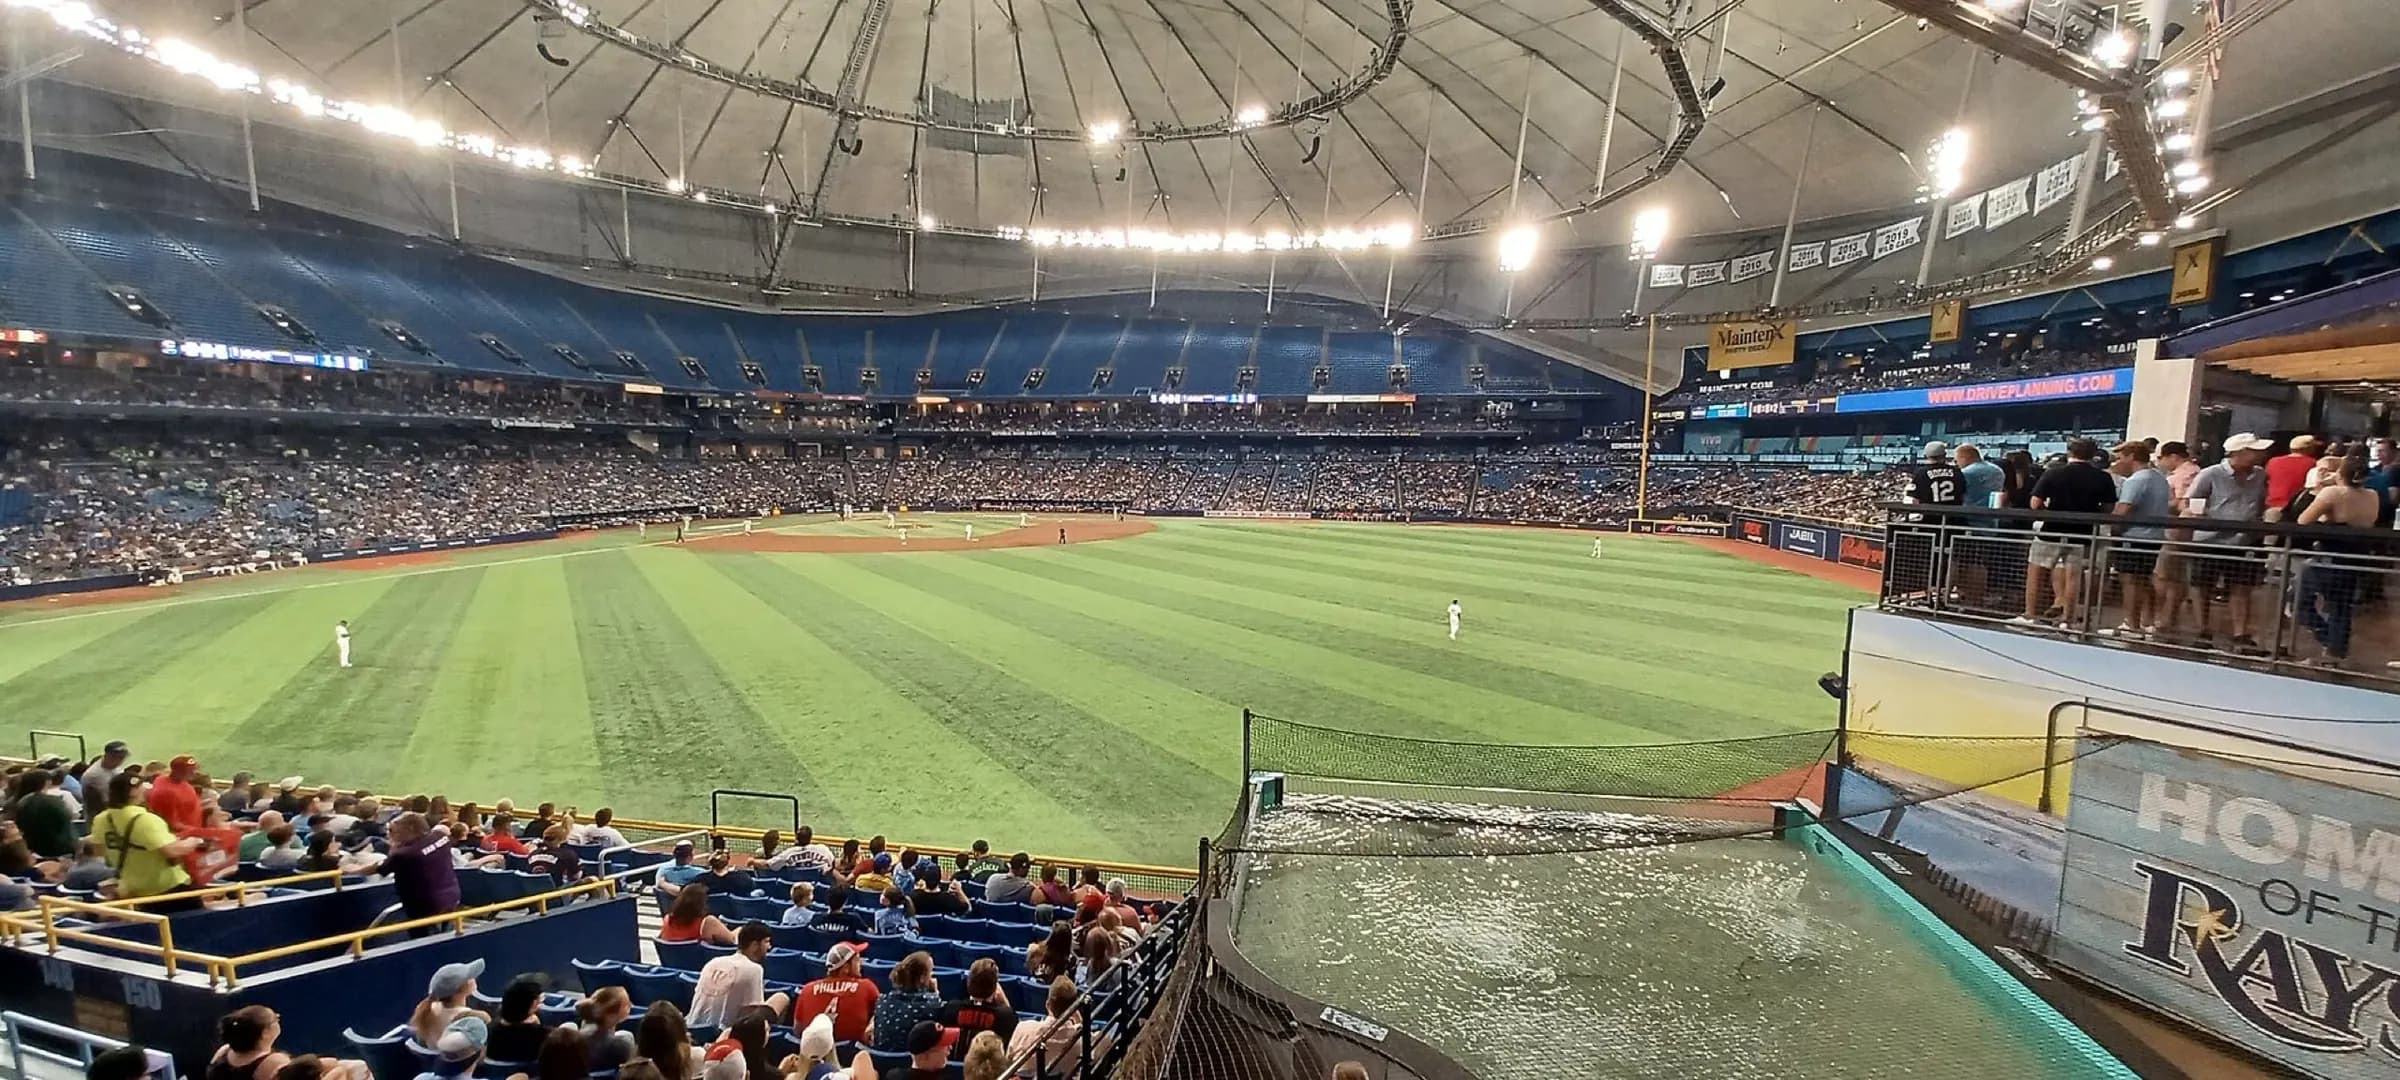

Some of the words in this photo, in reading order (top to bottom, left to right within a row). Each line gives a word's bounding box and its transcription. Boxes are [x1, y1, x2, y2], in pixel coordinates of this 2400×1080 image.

[1884, 228, 1909, 245] 2019
[1838, 242, 1858, 255] 2013
[1740, 260, 1761, 273] 2010
[1928, 374, 2116, 404] WWW.DRIVEPLANNING.COM
[1930, 480, 1955, 502] 12
[1789, 529, 1816, 544] JABIL
[2259, 878, 2341, 924] OF
[120, 975, 162, 1010] 150
[813, 981, 858, 995] PHILLIPS
